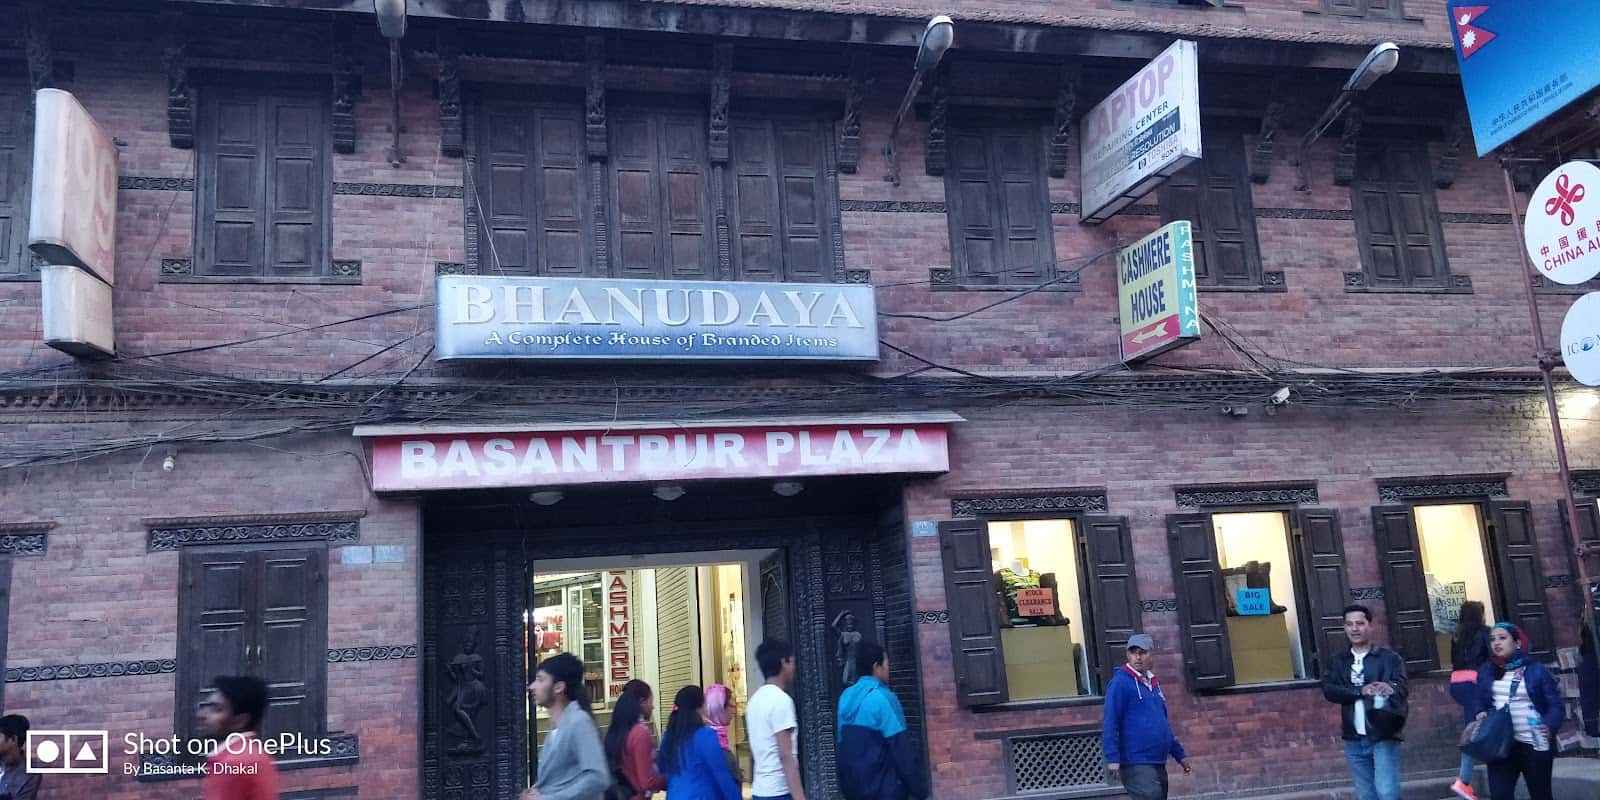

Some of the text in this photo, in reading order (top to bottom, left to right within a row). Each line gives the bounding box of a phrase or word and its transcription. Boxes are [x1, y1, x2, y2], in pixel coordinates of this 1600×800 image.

[1136, 101, 1169, 130] CENTER
[1131, 122, 1176, 161] RESOLUTION
[1120, 231, 1171, 285] CASHMERE
[1545, 246, 1584, 271] CHINA
[1180, 226, 1199, 329] PASHMINA
[451, 284, 865, 328] BHANUDAYA
[1130, 280, 1166, 325] HOUSE
[485, 332, 838, 350] A Complete House of Branded Items
[401, 428, 930, 480] BASANTPUR PLAZA
[1245, 591, 1260, 599] BIG
[1445, 585, 1465, 594] SALE
[1243, 603, 1264, 611] SALE
